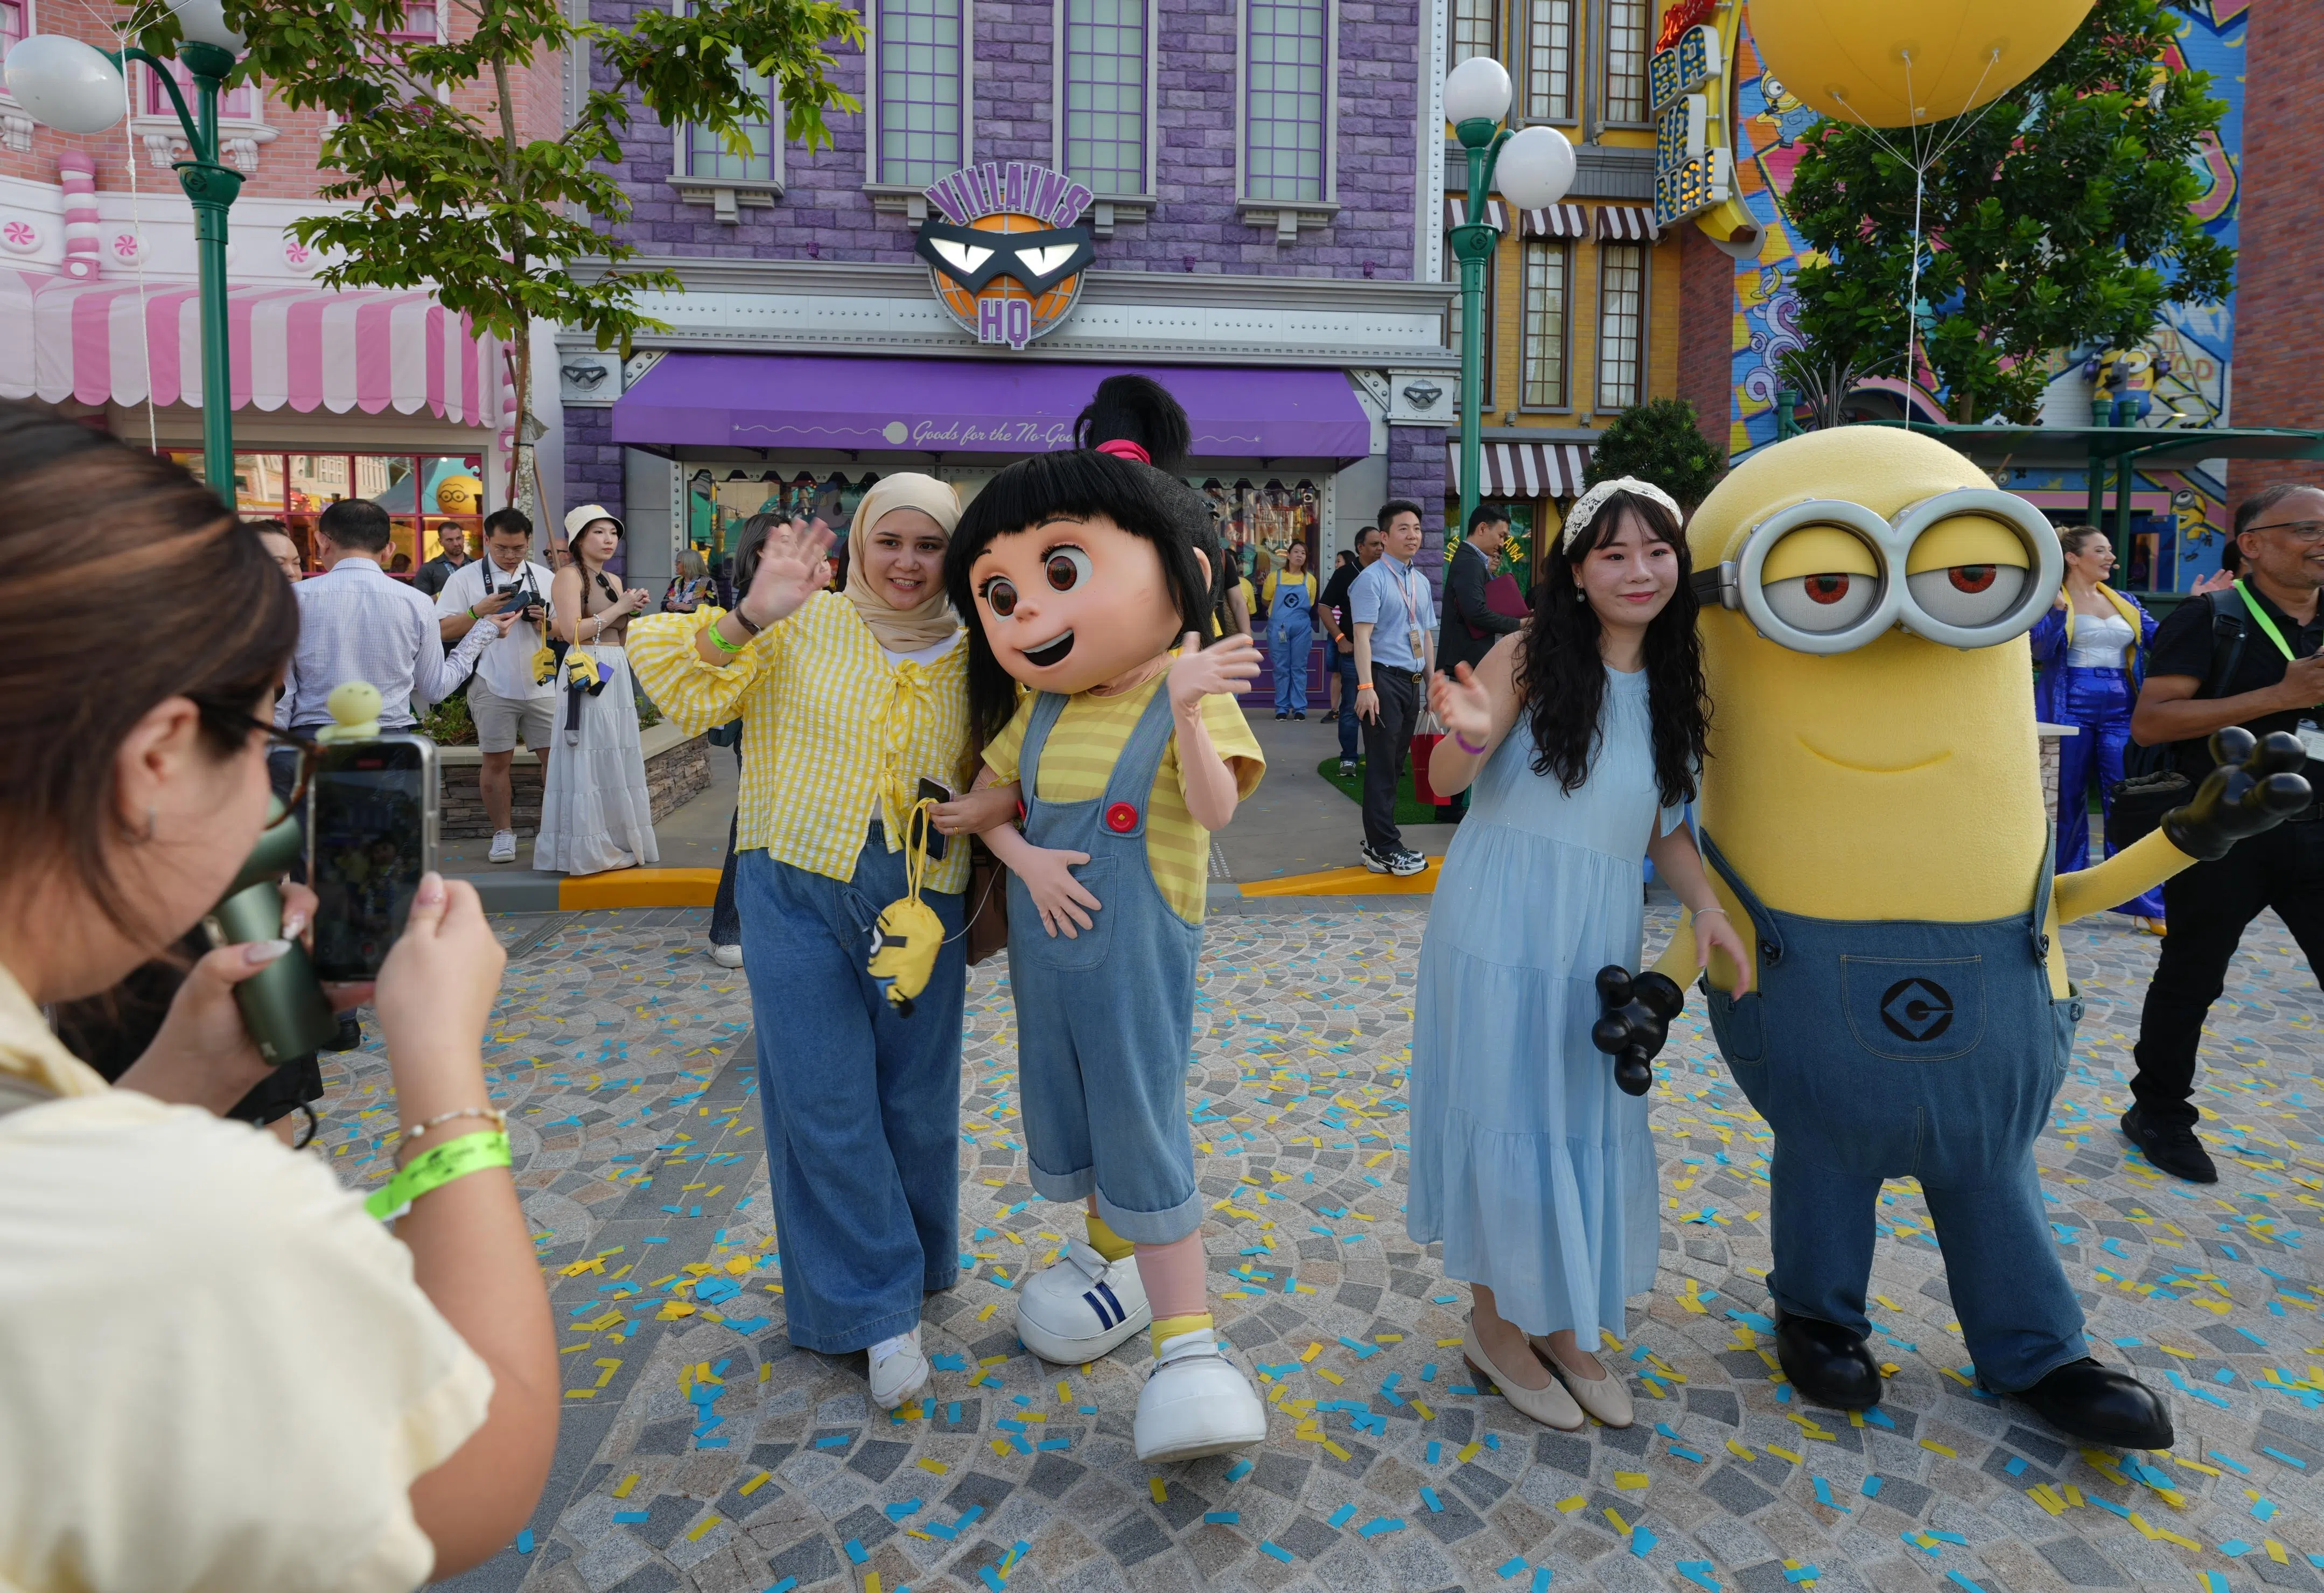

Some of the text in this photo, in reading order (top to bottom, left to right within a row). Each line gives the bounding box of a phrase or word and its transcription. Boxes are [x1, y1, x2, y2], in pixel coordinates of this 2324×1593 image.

[922, 162, 1094, 229] VILLAINS
[978, 297, 1031, 351] HQ
[913, 420, 959, 446] Goods
[960, 425, 986, 446] for
[989, 422, 1012, 441] the
[529, 574, 537, 591] SONY
